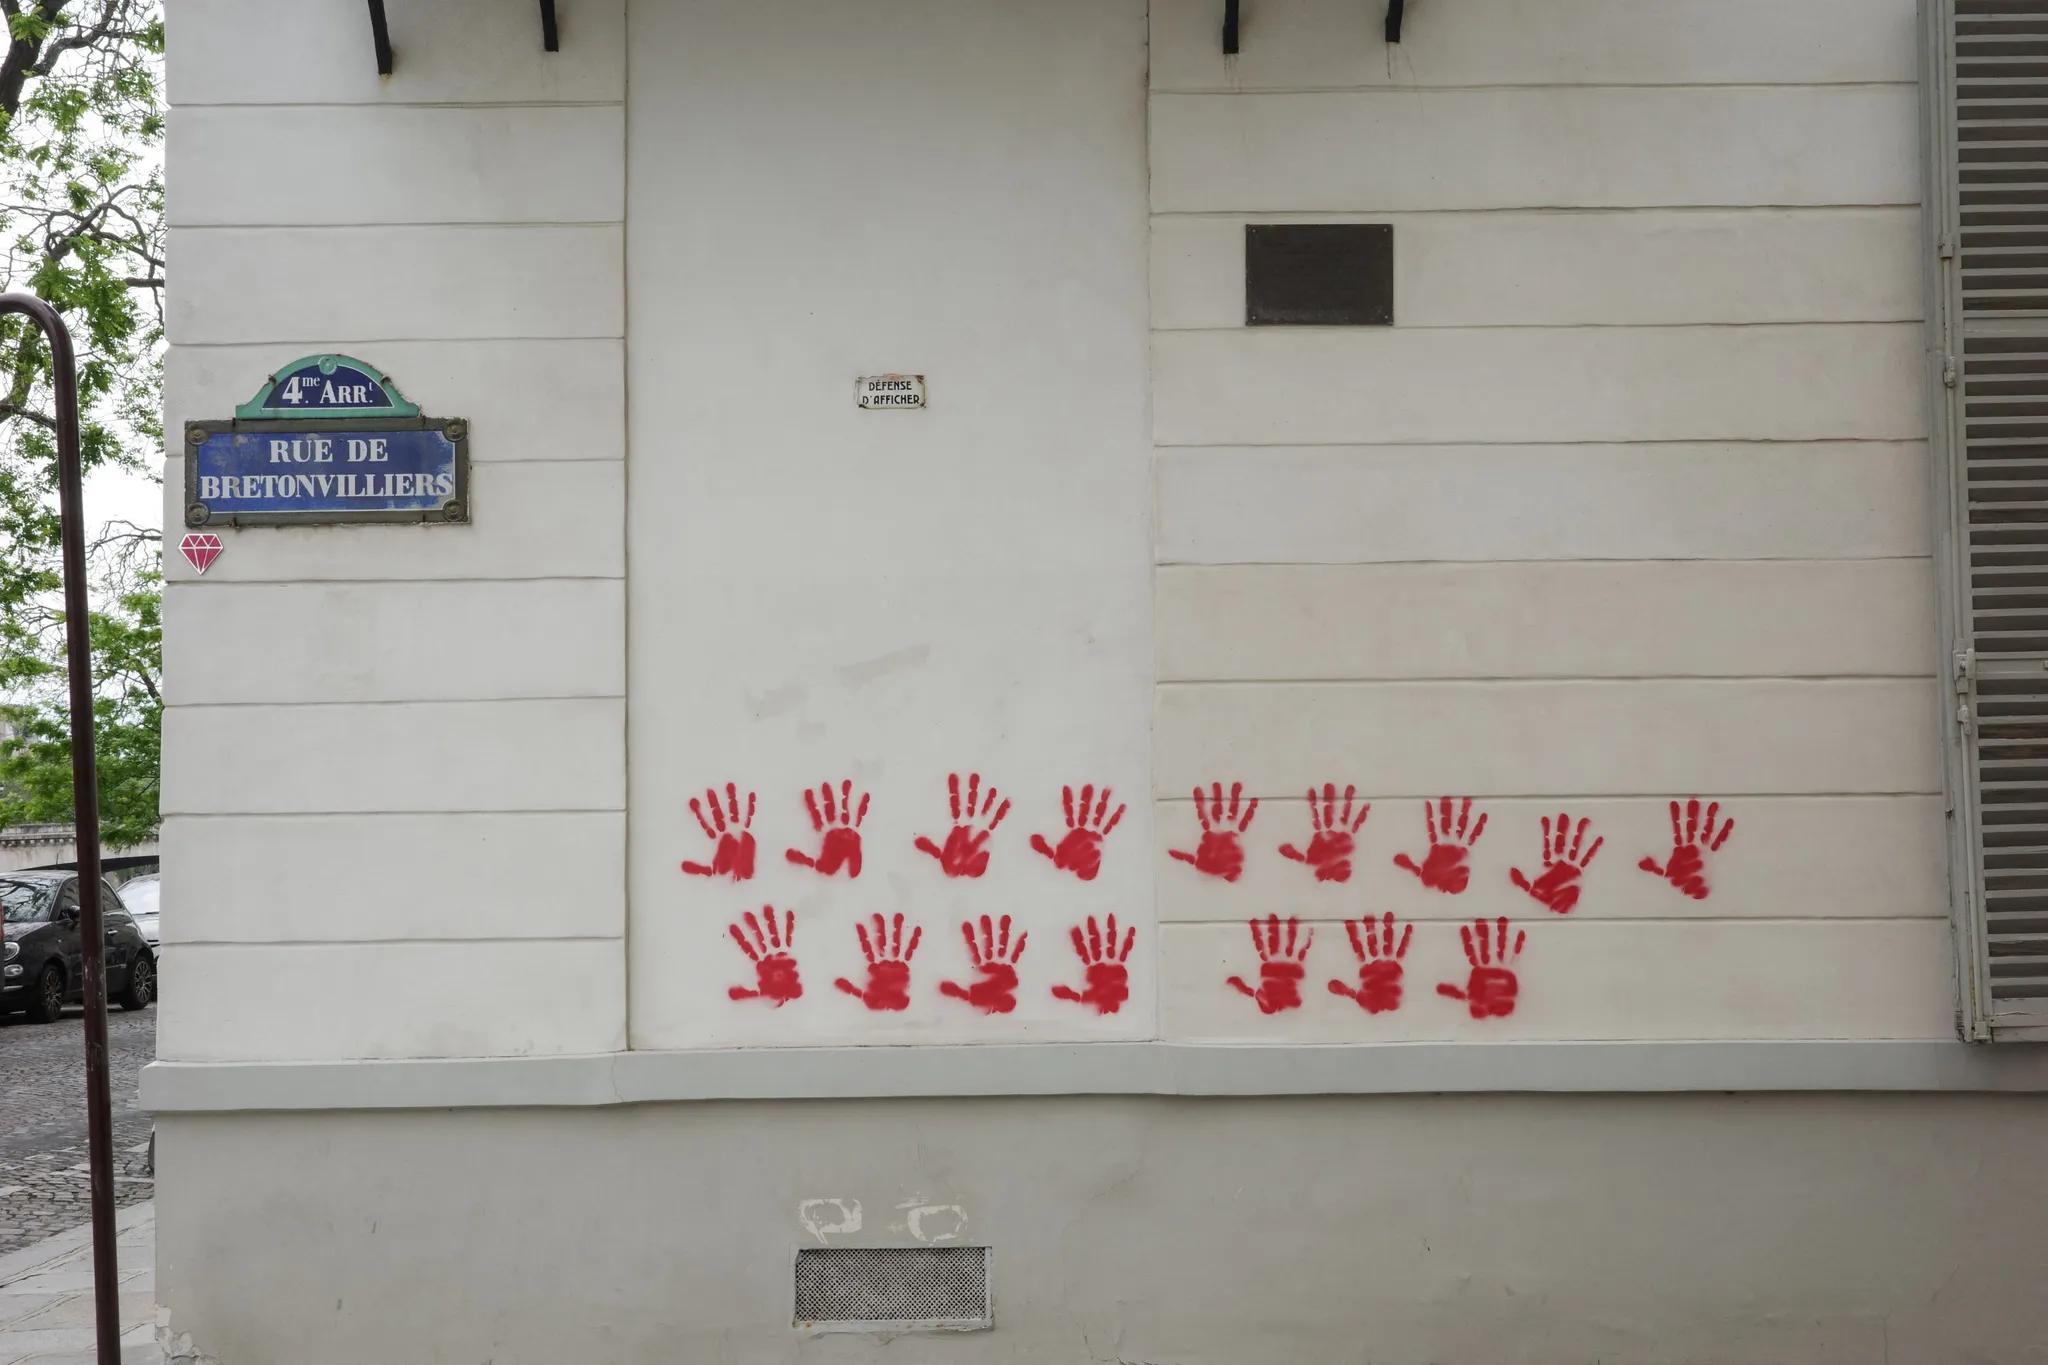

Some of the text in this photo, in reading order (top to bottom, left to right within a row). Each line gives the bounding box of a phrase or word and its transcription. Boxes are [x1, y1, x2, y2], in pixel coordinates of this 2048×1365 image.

[868, 380, 912, 391] DÉFENSE
[862, 394, 920, 405] D'AFFICHER
[269, 438, 388, 463] RUE DE
[200, 473, 454, 499] BRETONVILLIERS
